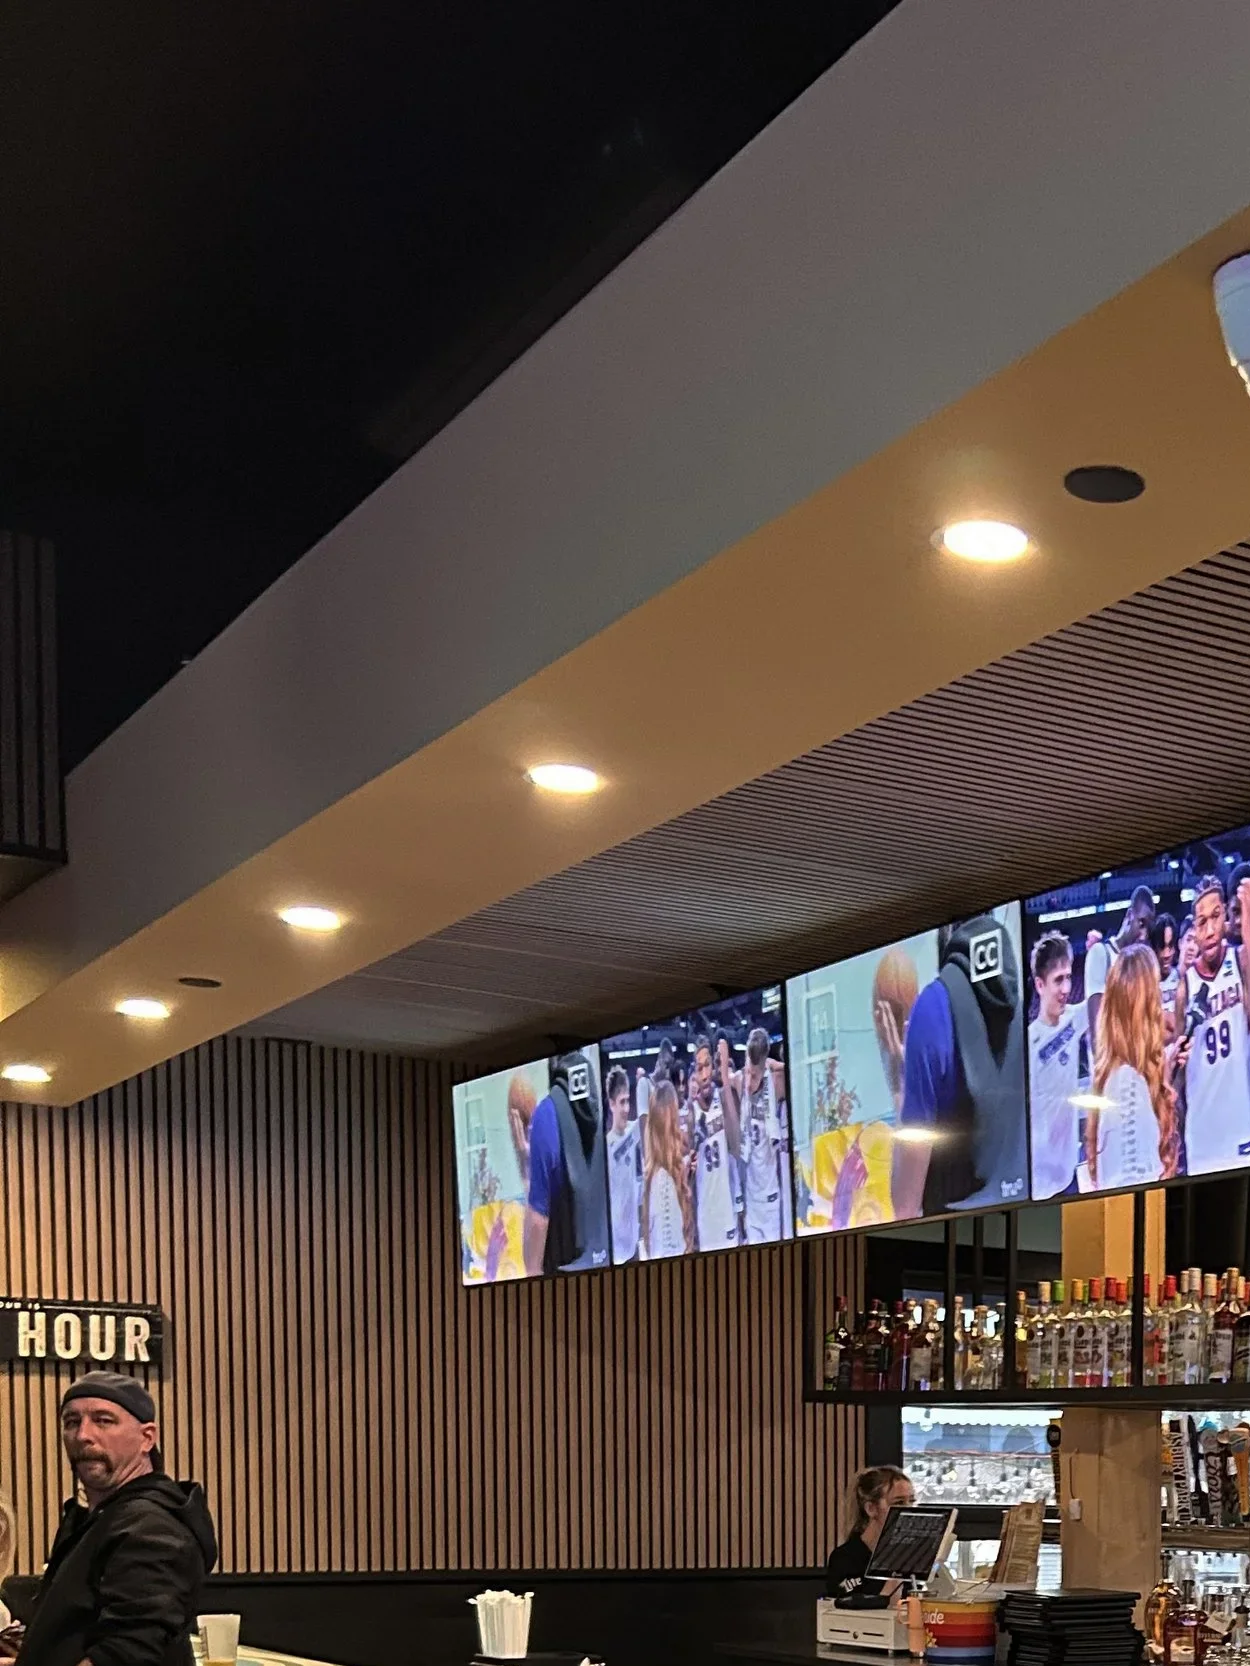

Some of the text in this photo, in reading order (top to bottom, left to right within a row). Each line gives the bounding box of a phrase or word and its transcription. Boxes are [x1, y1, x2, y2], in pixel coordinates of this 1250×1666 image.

[974, 942, 997, 970] CC
[1206, 1020, 1231, 1065] 99
[18, 1311, 150, 1362] HOUR
[1169, 1431, 1187, 1477] ASBURY
